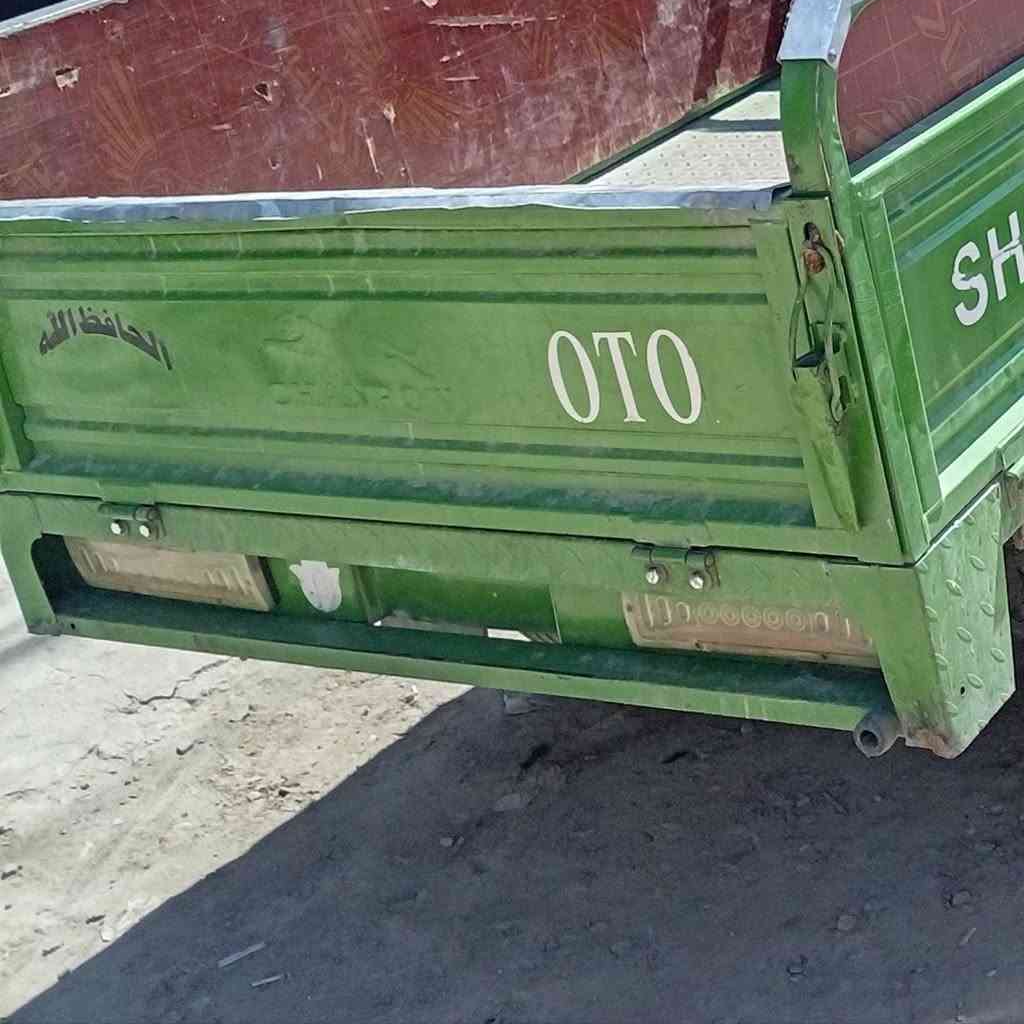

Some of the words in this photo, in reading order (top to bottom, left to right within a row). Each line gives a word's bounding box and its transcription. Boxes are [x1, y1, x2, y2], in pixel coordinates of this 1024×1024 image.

[39, 307, 78, 356] الله
[78, 306, 173, 371] الحافظ
[547, 329, 703, 425] OTO
